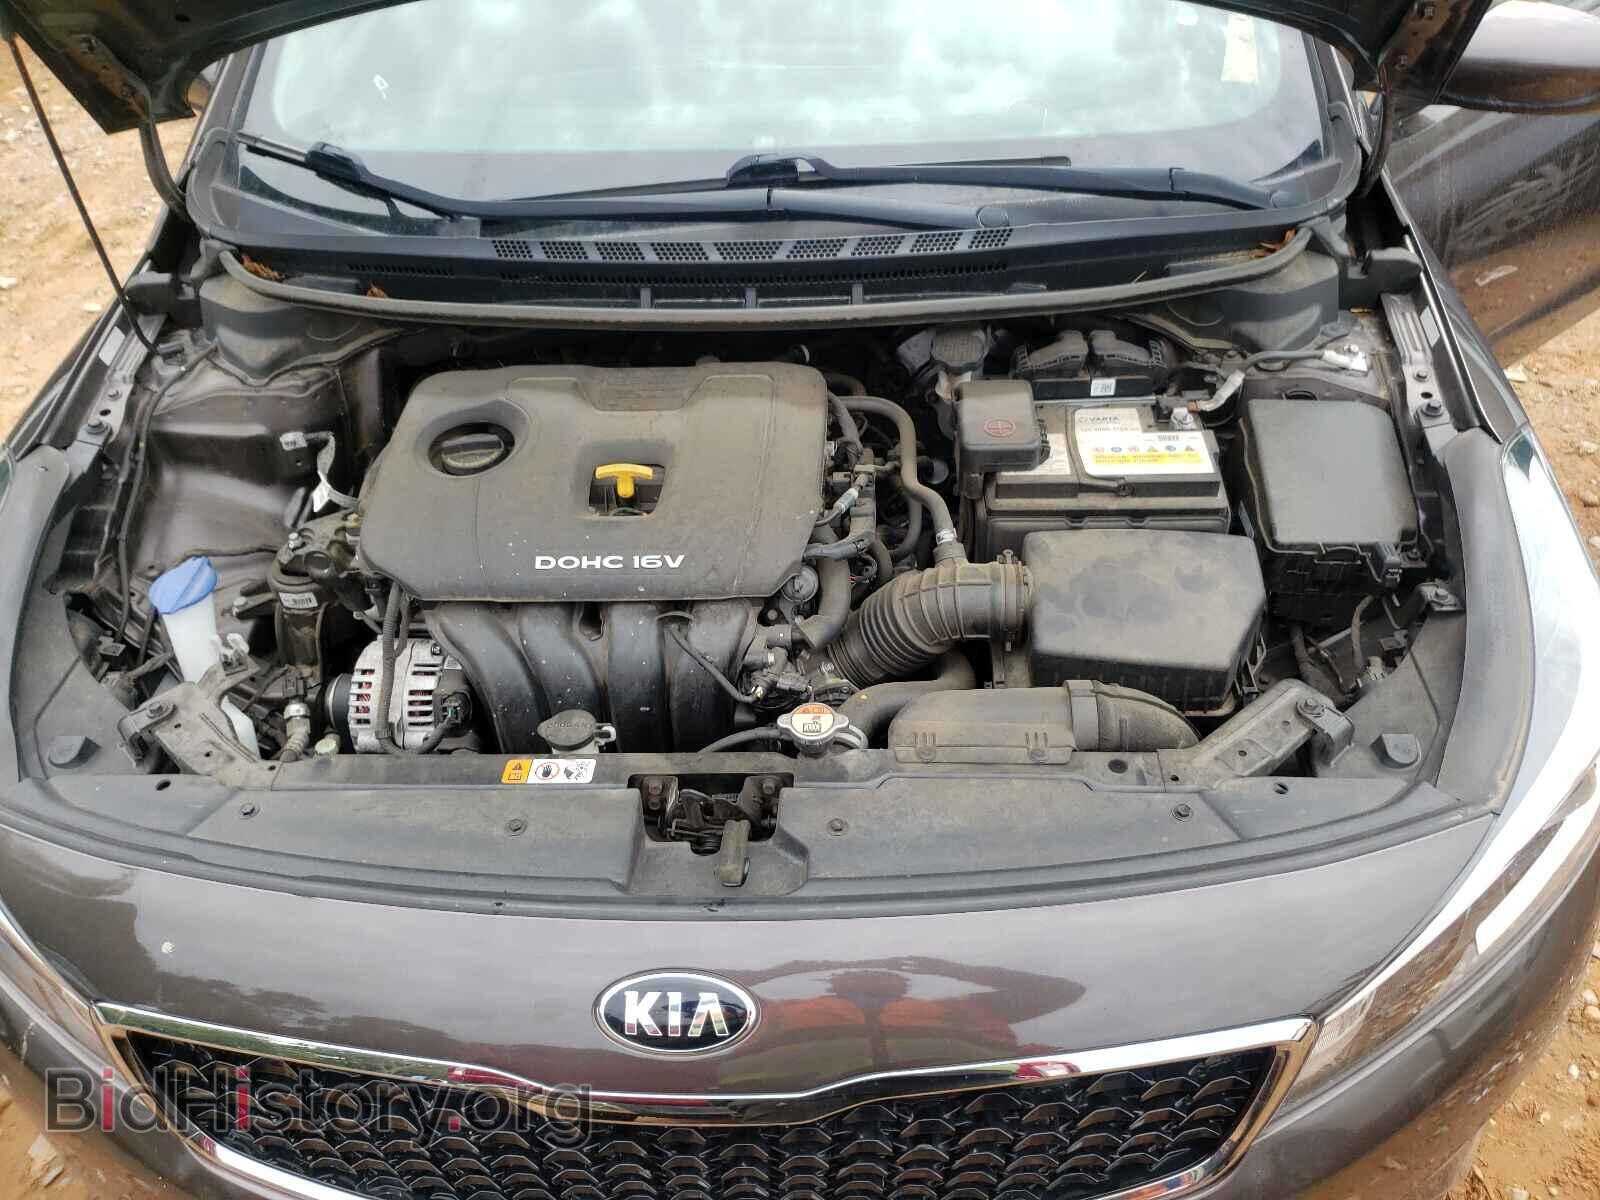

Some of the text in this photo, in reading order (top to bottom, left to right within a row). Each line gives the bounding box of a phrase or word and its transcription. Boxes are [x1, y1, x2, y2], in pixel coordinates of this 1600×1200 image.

[535, 554, 685, 569] DOHC 16V
[624, 991, 730, 1036] KIA
